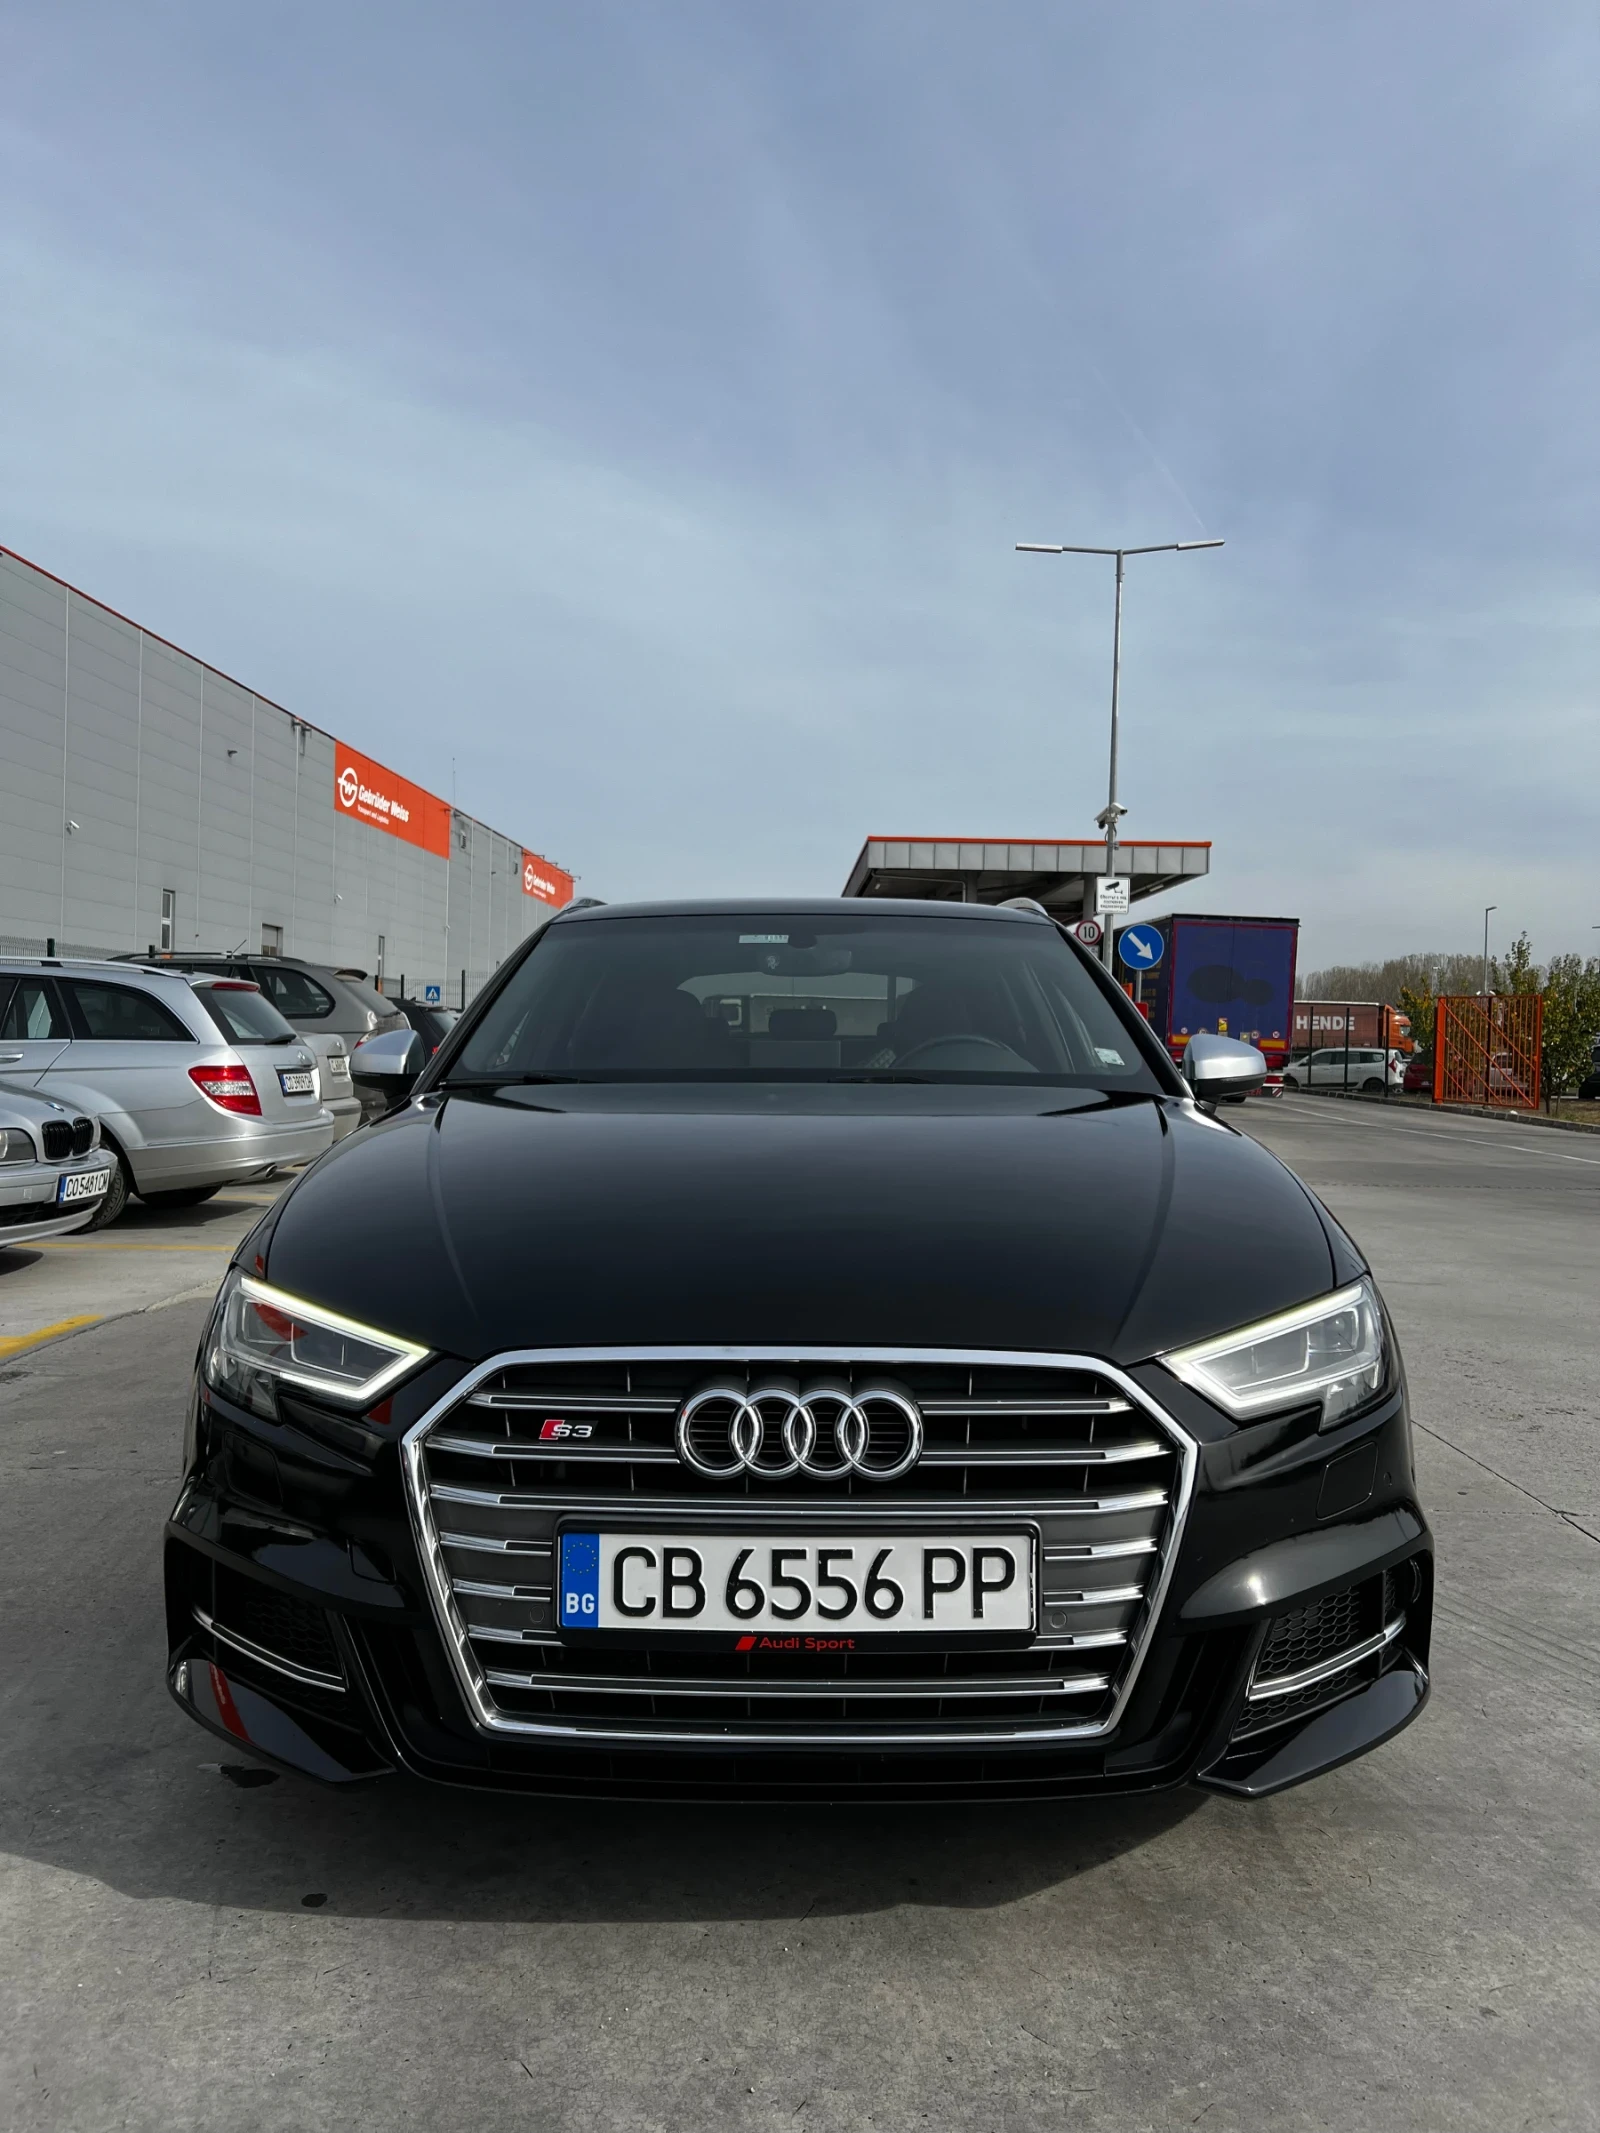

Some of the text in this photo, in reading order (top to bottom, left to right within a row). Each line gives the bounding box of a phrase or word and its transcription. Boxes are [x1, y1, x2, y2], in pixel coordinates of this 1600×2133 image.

[358, 784, 409, 823] Gebrüder Weiss
[1083, 926, 1095, 939] 10
[551, 1424, 593, 1438] S3
[612, 1547, 1016, 1620] CB 6556 PP
[566, 1593, 595, 1614] BG
[759, 1637, 855, 1651] Audi Sport
